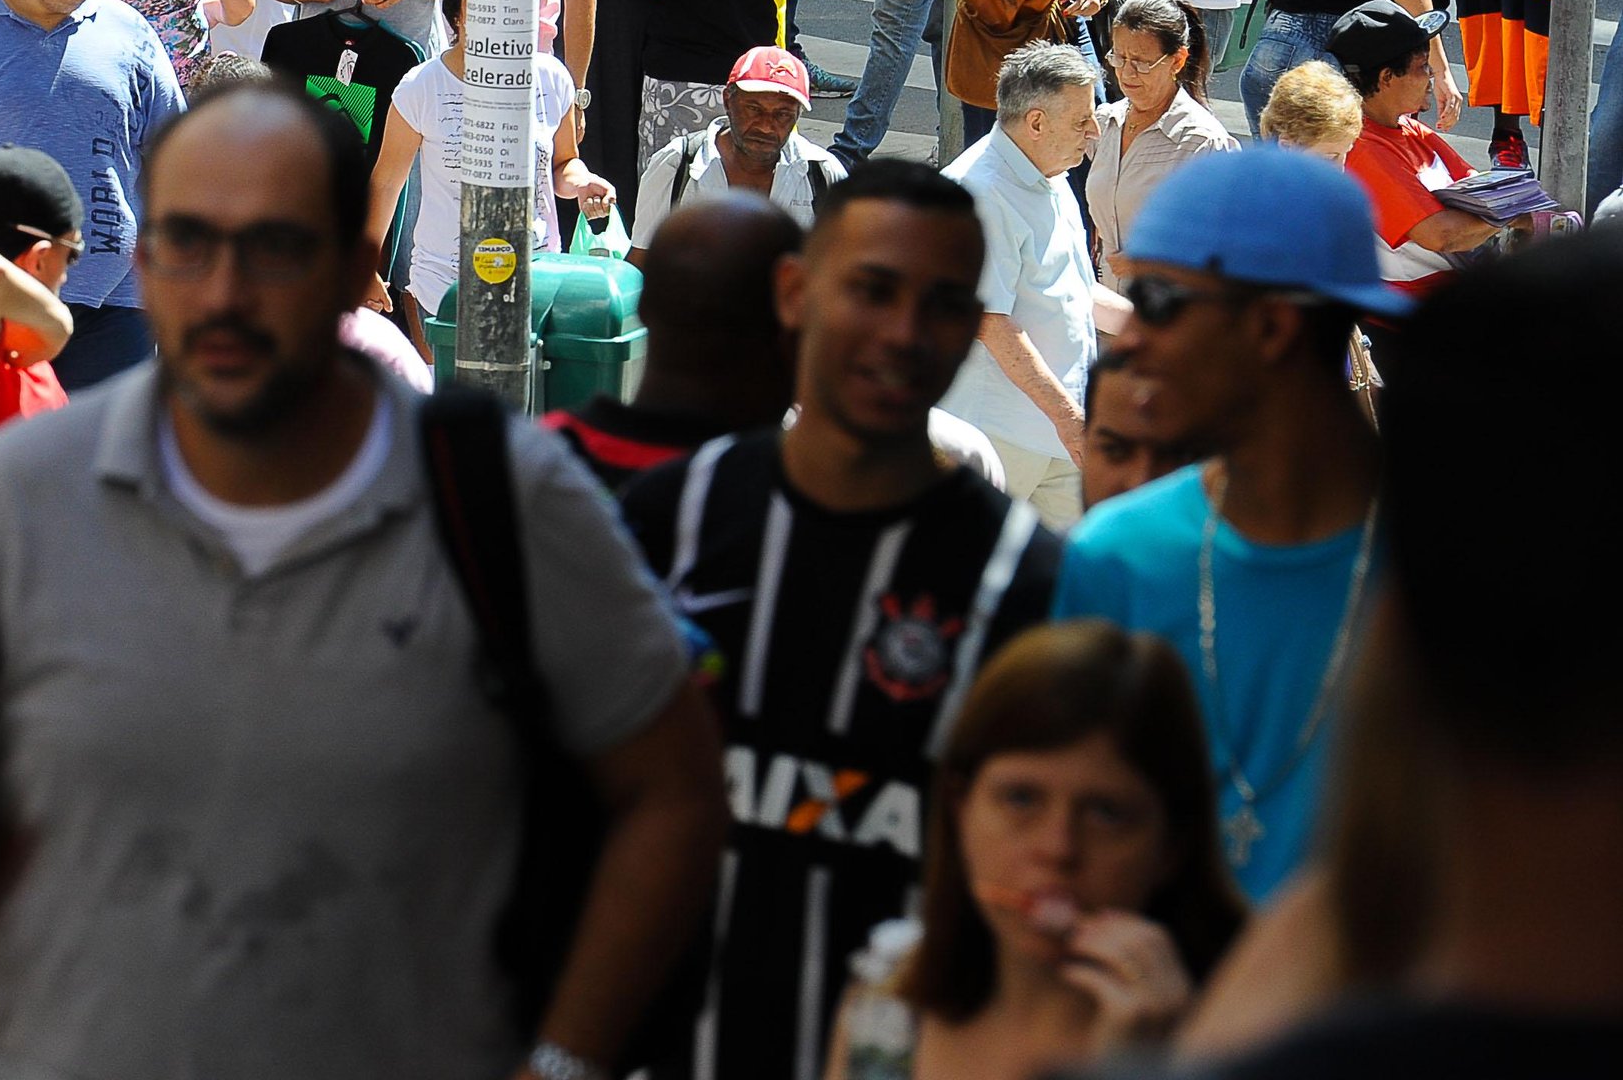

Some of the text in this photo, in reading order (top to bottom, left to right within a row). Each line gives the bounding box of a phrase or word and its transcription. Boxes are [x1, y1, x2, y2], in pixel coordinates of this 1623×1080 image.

[503, 17, 524, 26] Claro
[502, 122, 519, 131] Fixo
[501, 135, 519, 144] vivo
[500, 148, 510, 156] Oi
[499, 161, 515, 169] Tim
[499, 173, 521, 181] Claro
